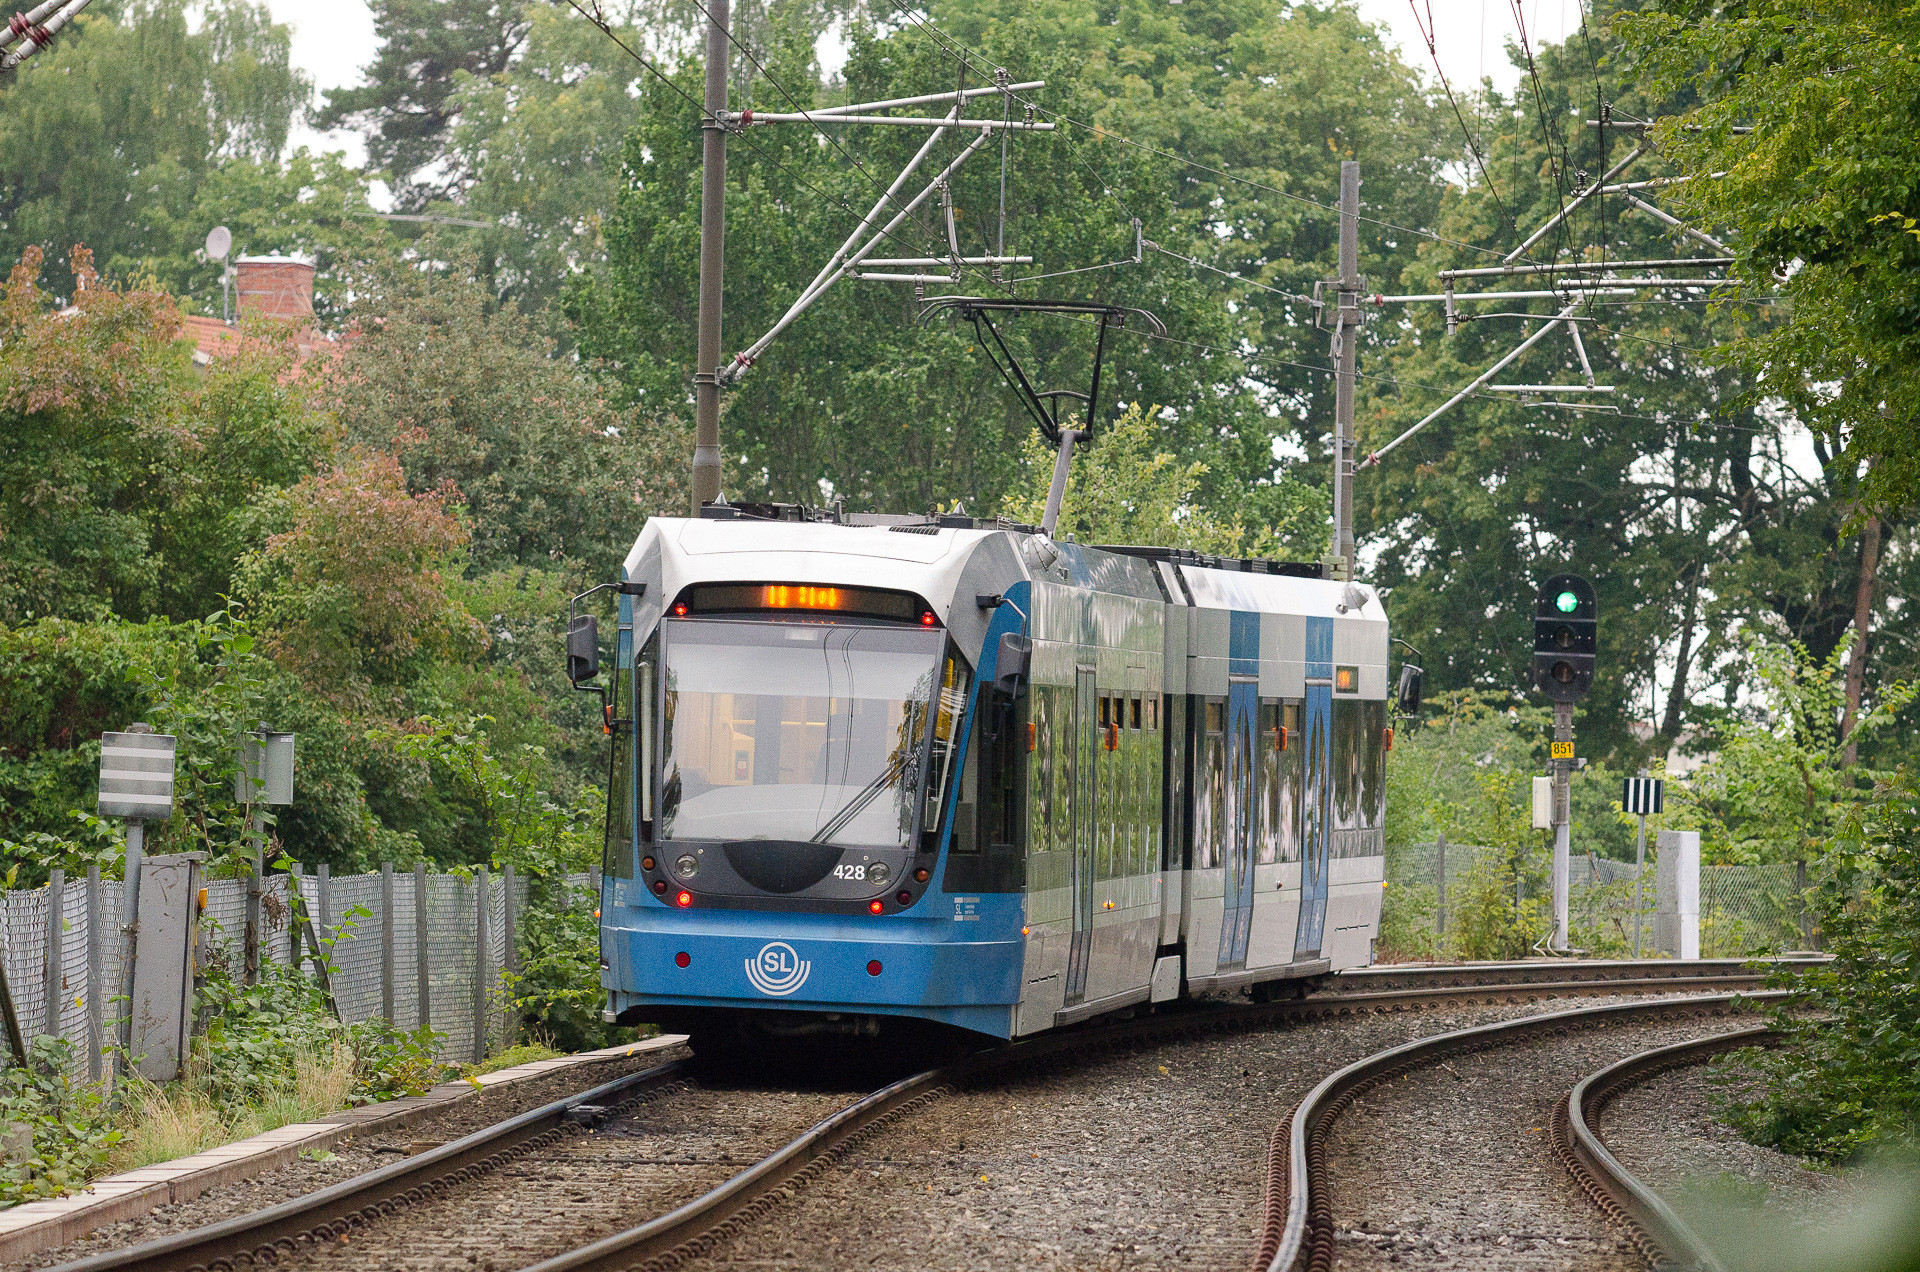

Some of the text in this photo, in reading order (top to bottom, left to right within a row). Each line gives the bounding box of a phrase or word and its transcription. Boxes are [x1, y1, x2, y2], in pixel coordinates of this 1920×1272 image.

[1553, 743, 1572, 754] 851
[833, 864, 865, 880] 428
[764, 951, 792, 973] SL
